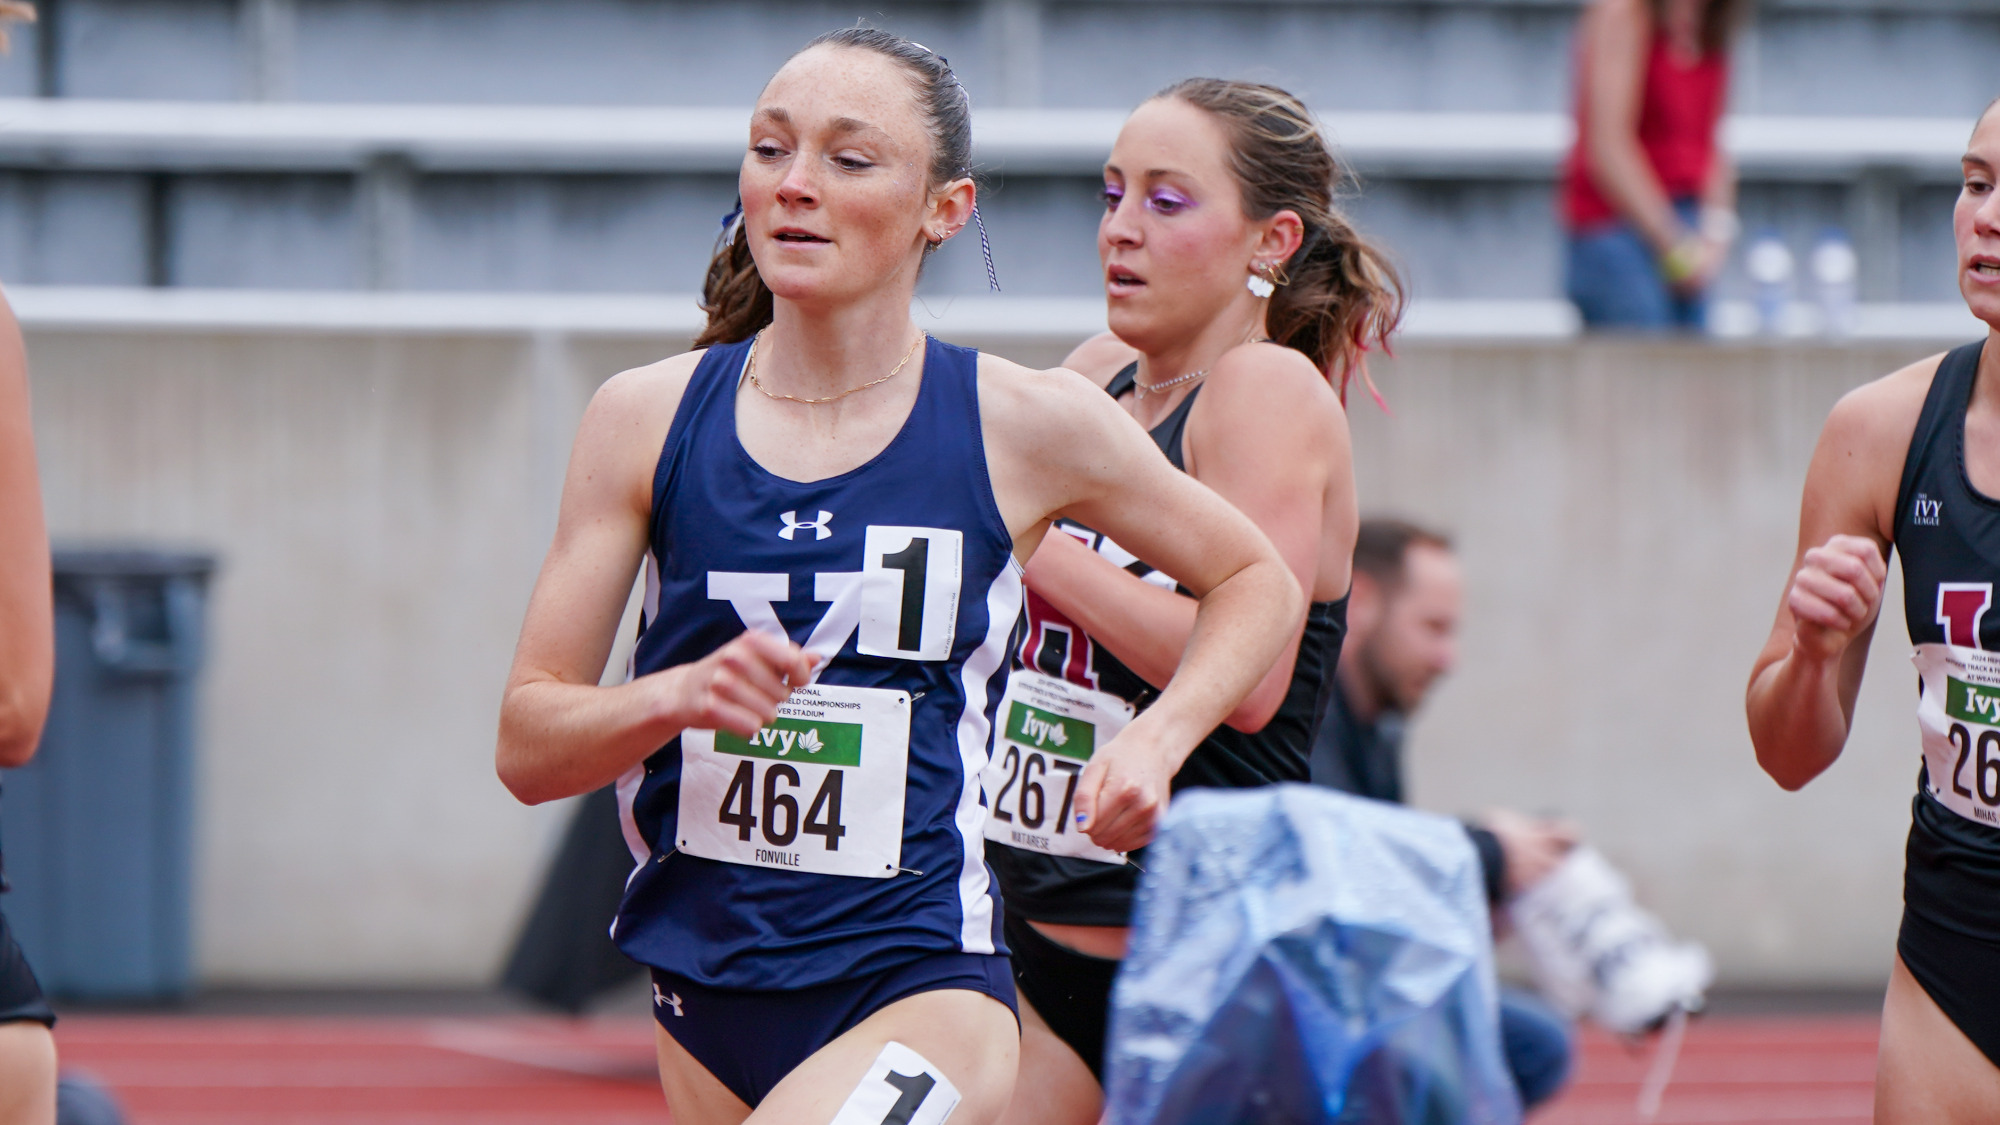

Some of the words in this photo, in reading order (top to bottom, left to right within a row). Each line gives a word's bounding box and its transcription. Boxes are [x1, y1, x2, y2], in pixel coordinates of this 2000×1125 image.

[1914, 500, 1943, 517] IVY
[882, 537, 930, 652] 1
[791, 687, 822, 696] AGONAL
[802, 699, 861, 710] CHAMPIONSHIPS
[793, 708, 825, 718] STADIUM
[1021, 709, 1051, 747] Ivy
[1948, 722, 2000, 807] 26
[993, 745, 1084, 835] 267
[718, 759, 846, 852] 464
[755, 848, 800, 867] FONVILLE
